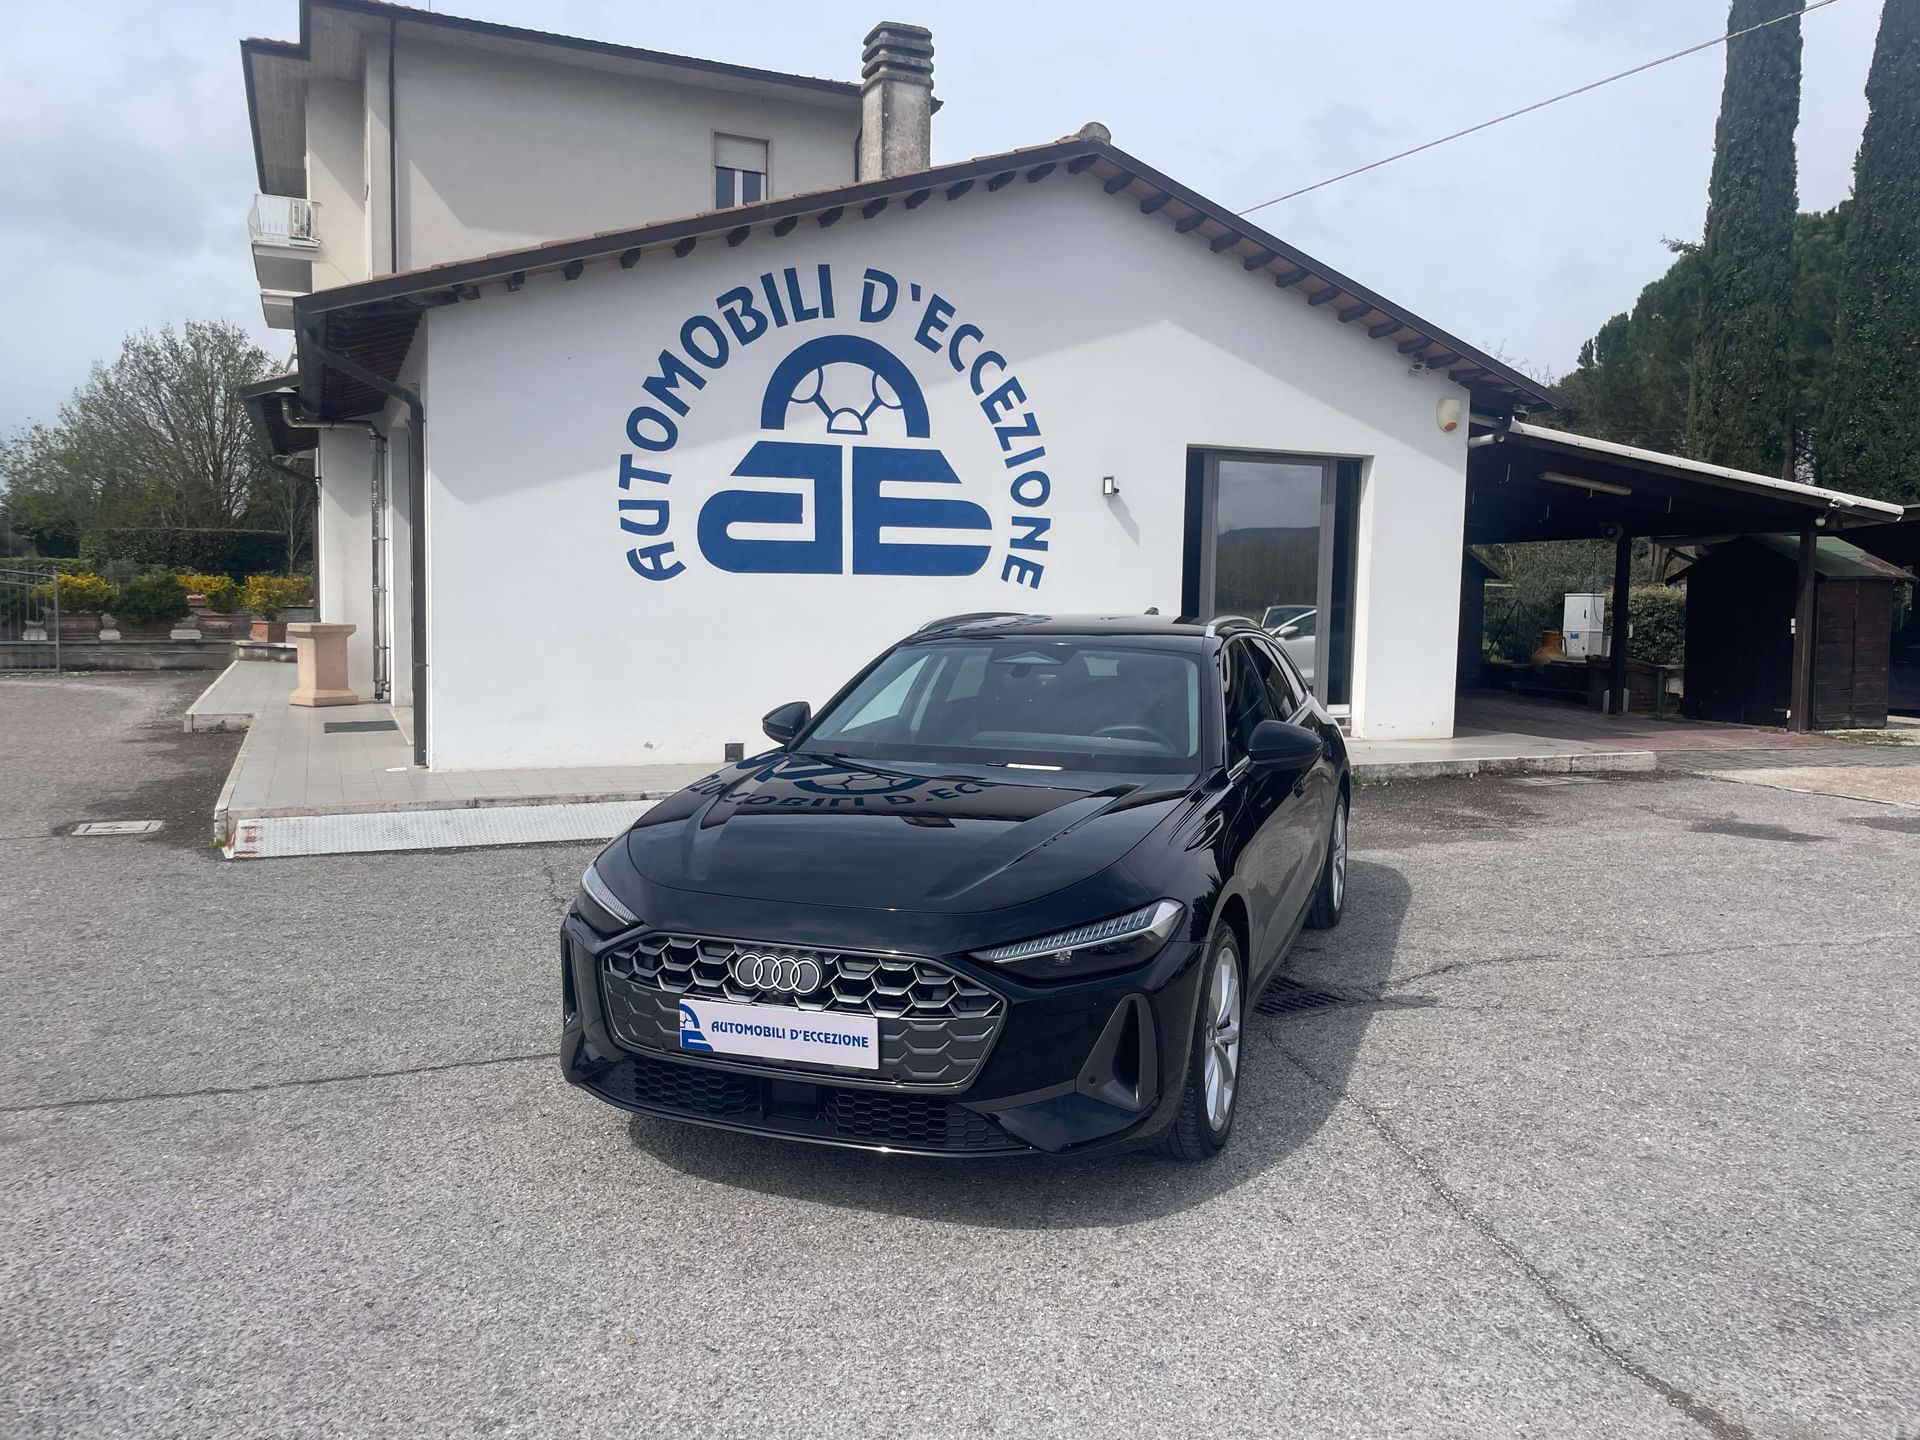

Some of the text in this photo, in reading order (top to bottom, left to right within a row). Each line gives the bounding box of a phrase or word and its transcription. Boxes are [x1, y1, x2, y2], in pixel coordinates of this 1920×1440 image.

[618, 264, 1052, 590] AUTOMOBILI D'ECCEZIONE
[711, 1020, 870, 1048] AUTOMOBILI D'ECCEZIONE
